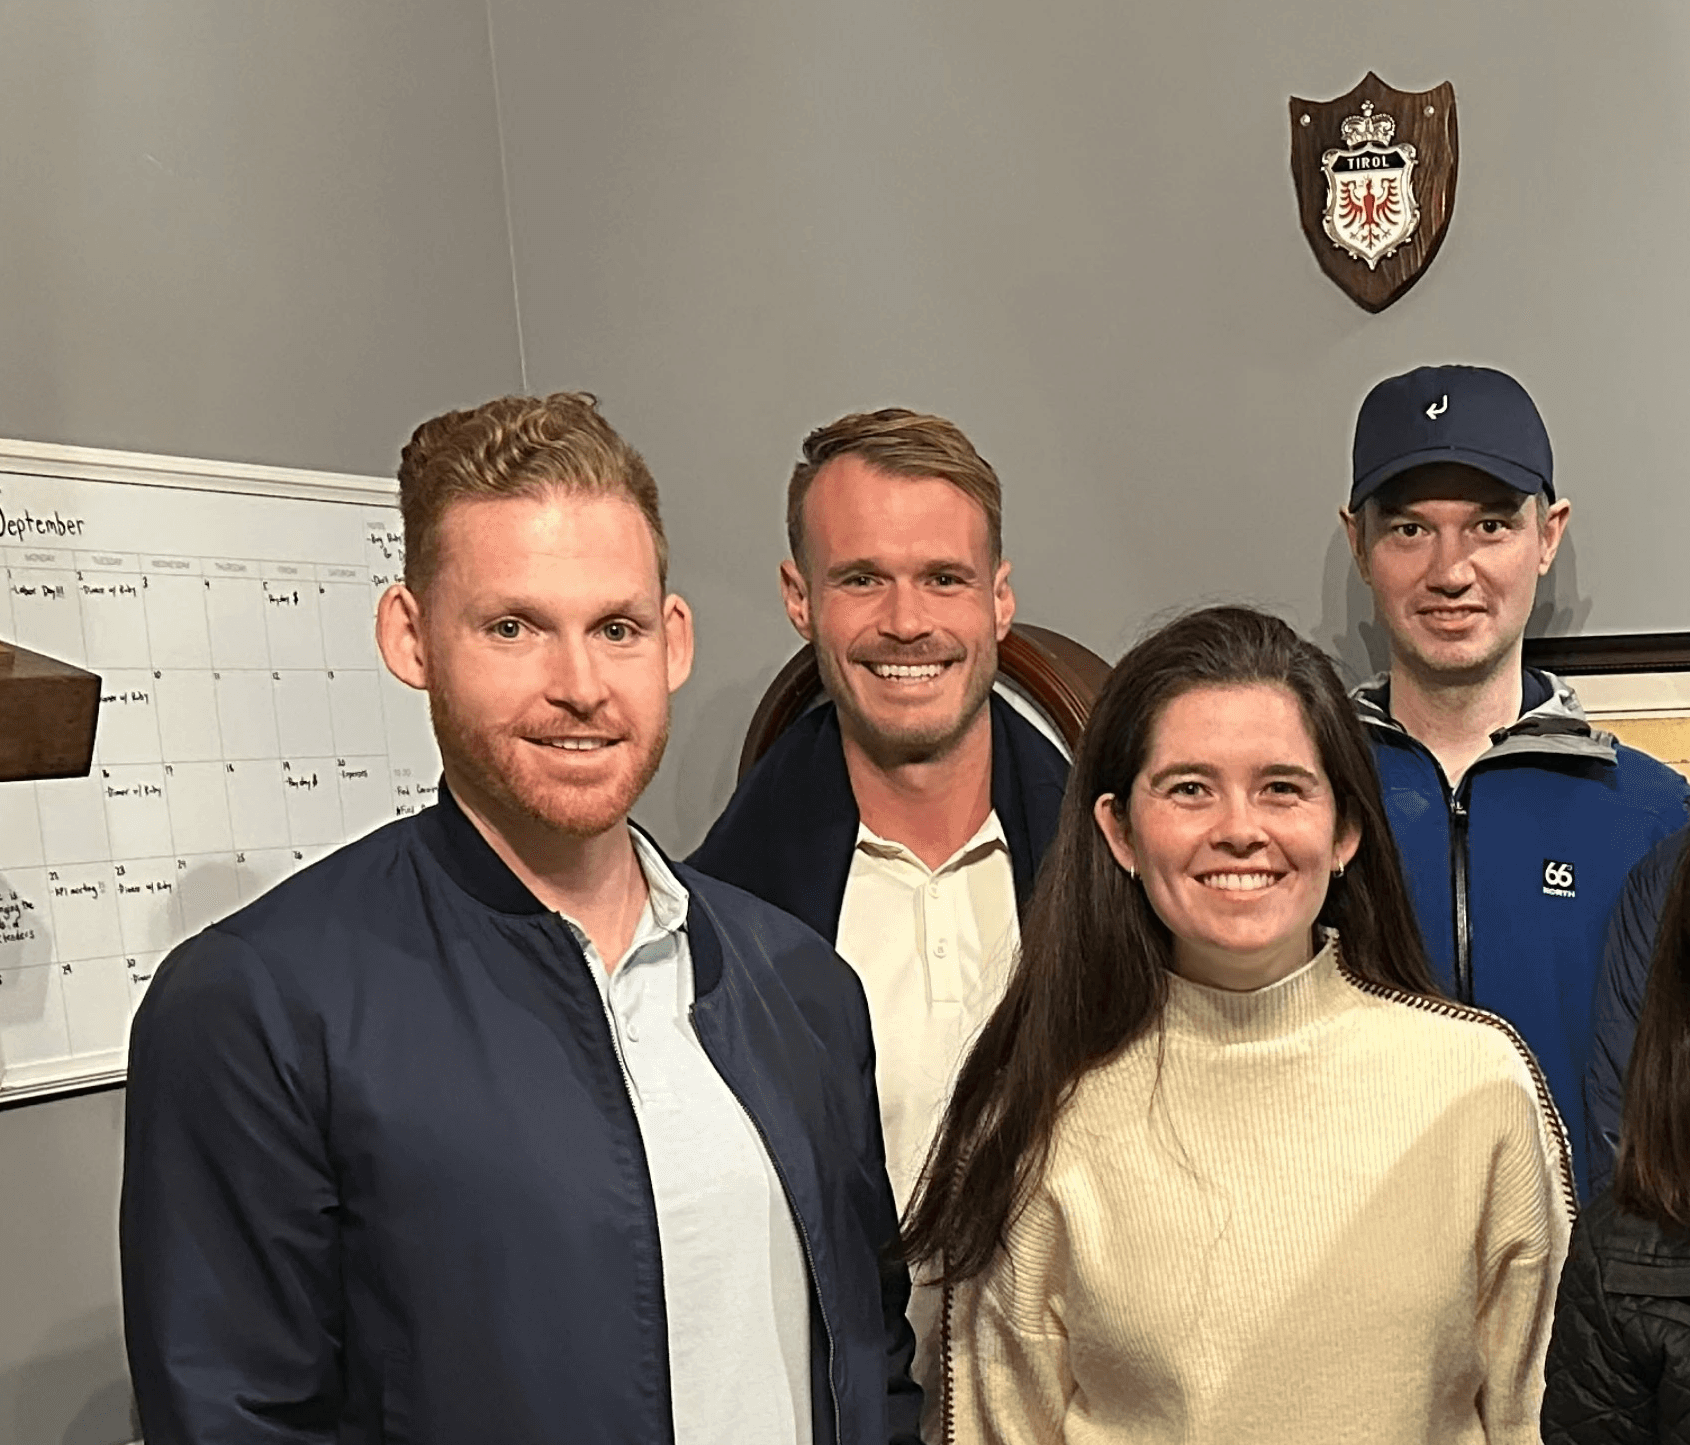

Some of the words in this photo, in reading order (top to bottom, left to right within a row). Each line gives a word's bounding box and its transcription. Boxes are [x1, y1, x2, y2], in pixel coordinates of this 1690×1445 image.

[1347, 155, 1390, 170] TIROL
[142, 576, 149, 589] 3
[204, 580, 211, 590] 4
